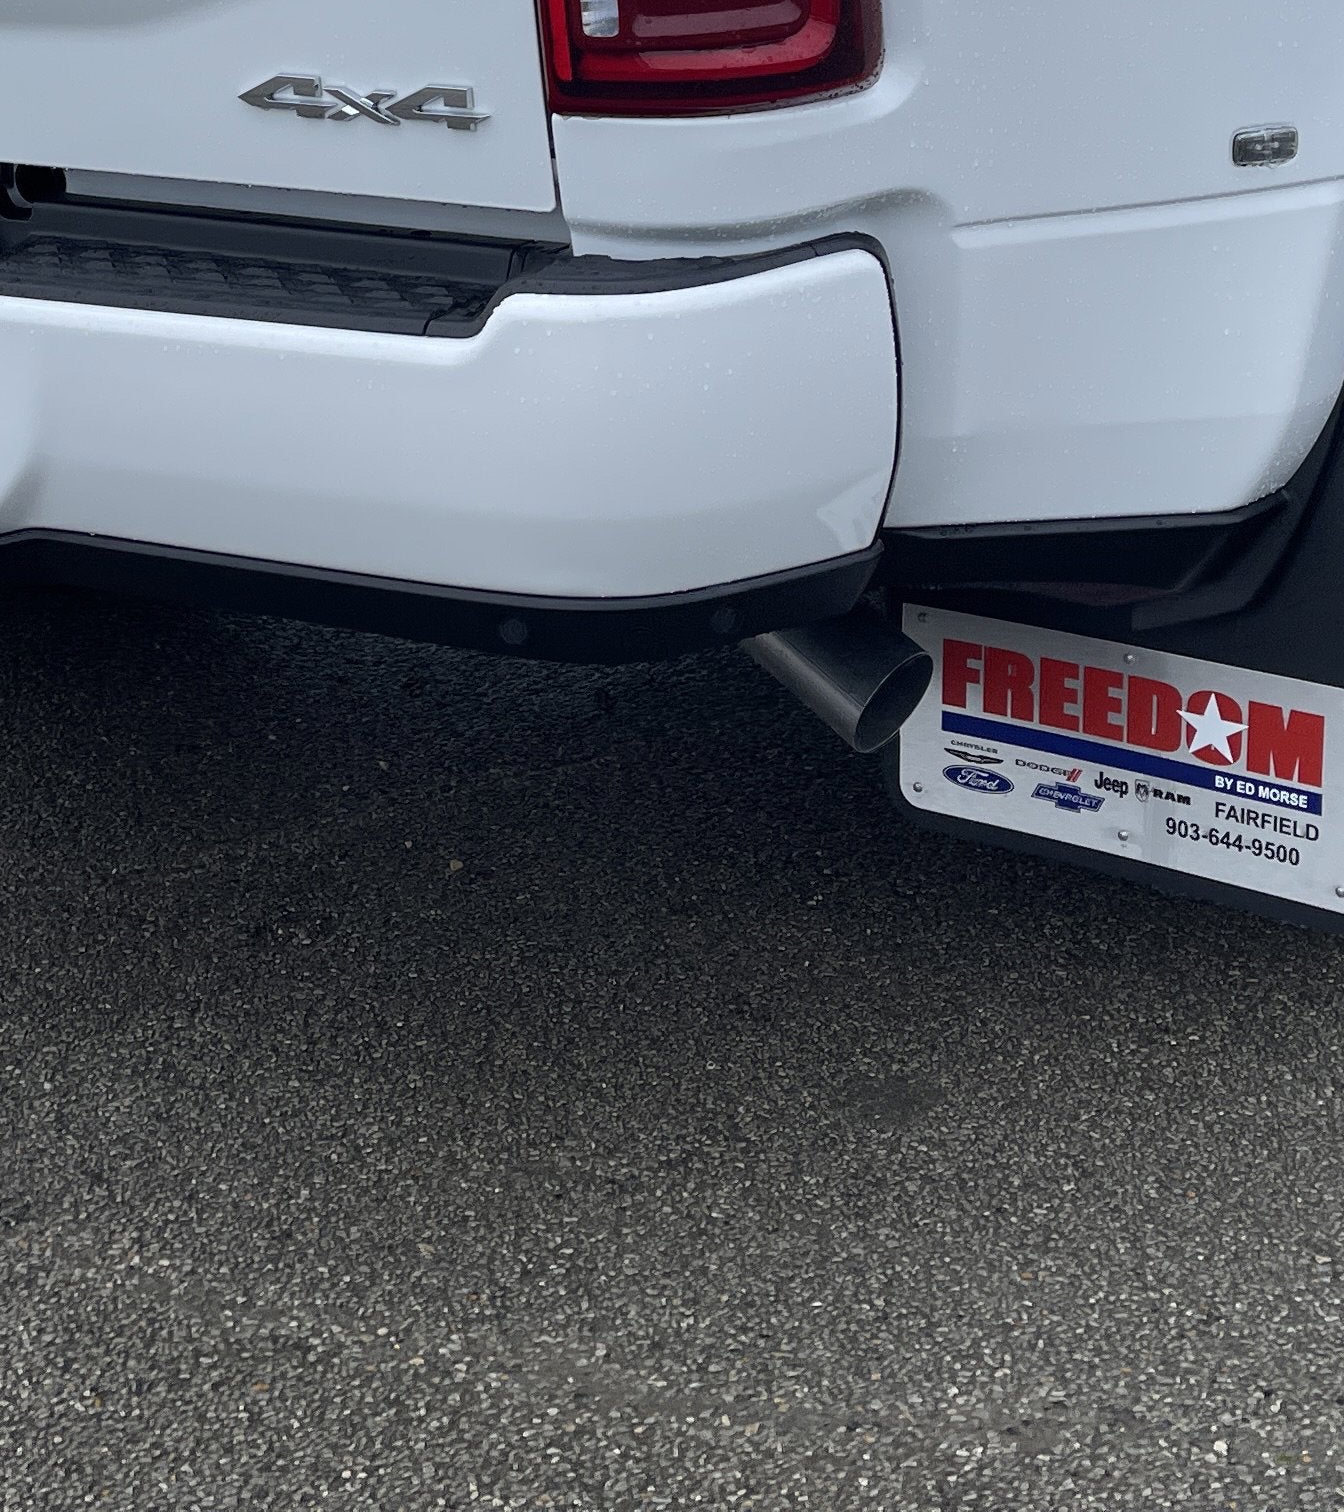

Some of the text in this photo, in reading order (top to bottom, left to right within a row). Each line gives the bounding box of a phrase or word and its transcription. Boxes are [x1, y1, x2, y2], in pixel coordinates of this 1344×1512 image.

[941, 637, 1326, 790] FREEDOM
[949, 739, 999, 755] CHRYSLER
[955, 767, 1000, 792] Ford
[1093, 770, 1130, 799] Jeep
[1214, 775, 1309, 809] BY ED MORSE
[1037, 787, 1100, 808] CHEVROLET
[1153, 787, 1193, 807] RAM
[1214, 801, 1320, 842] FAIRFIELD
[1164, 816, 1301, 867] 903-644-9500
